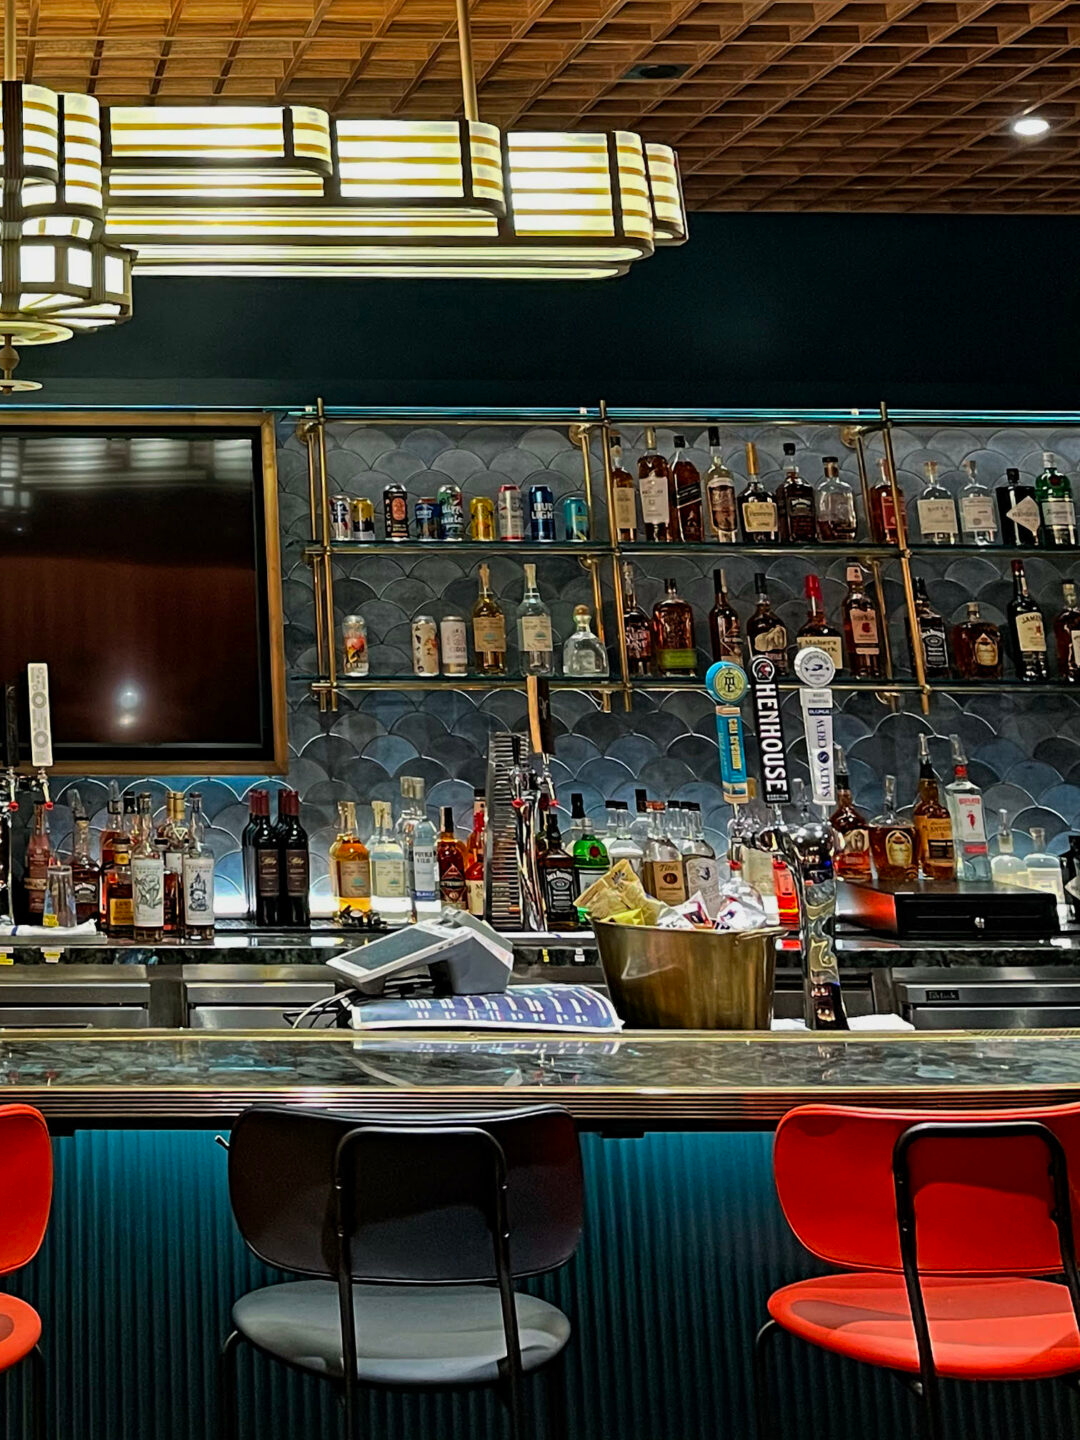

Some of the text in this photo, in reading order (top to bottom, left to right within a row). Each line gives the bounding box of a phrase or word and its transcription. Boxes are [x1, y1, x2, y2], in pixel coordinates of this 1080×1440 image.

[531, 511, 553, 520] LIGH
[533, 503, 553, 511] BUD
[755, 683, 789, 792] HENHOUSE
[816, 719, 832, 798] SALTY CREW
